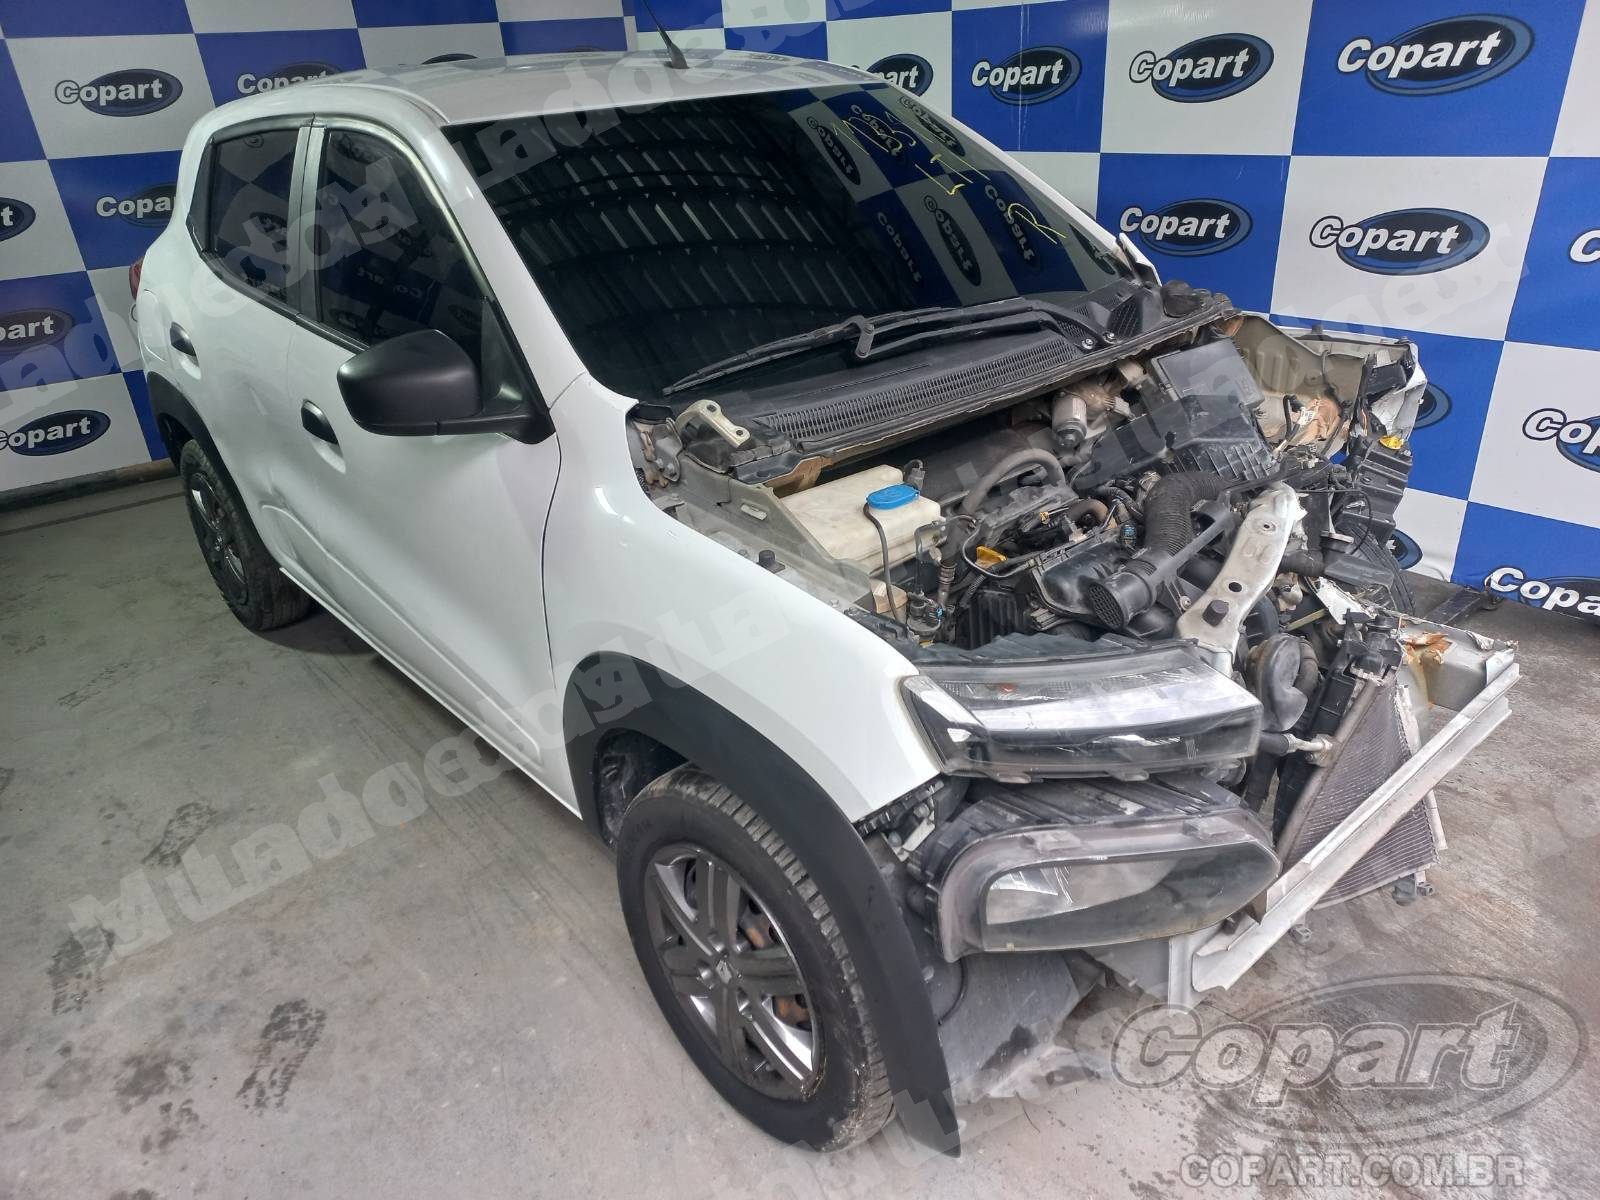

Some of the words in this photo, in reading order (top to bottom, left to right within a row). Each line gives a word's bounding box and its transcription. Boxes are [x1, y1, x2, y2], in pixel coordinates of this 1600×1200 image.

[1129, 48, 1250, 88] Copart
[1339, 30, 1502, 80] Copart
[55, 78, 164, 106] Copart
[971, 58, 1064, 92] Copart
[96, 196, 175, 219] Copa
[1119, 206, 1231, 241] Copart
[1309, 215, 1460, 256] Copart
